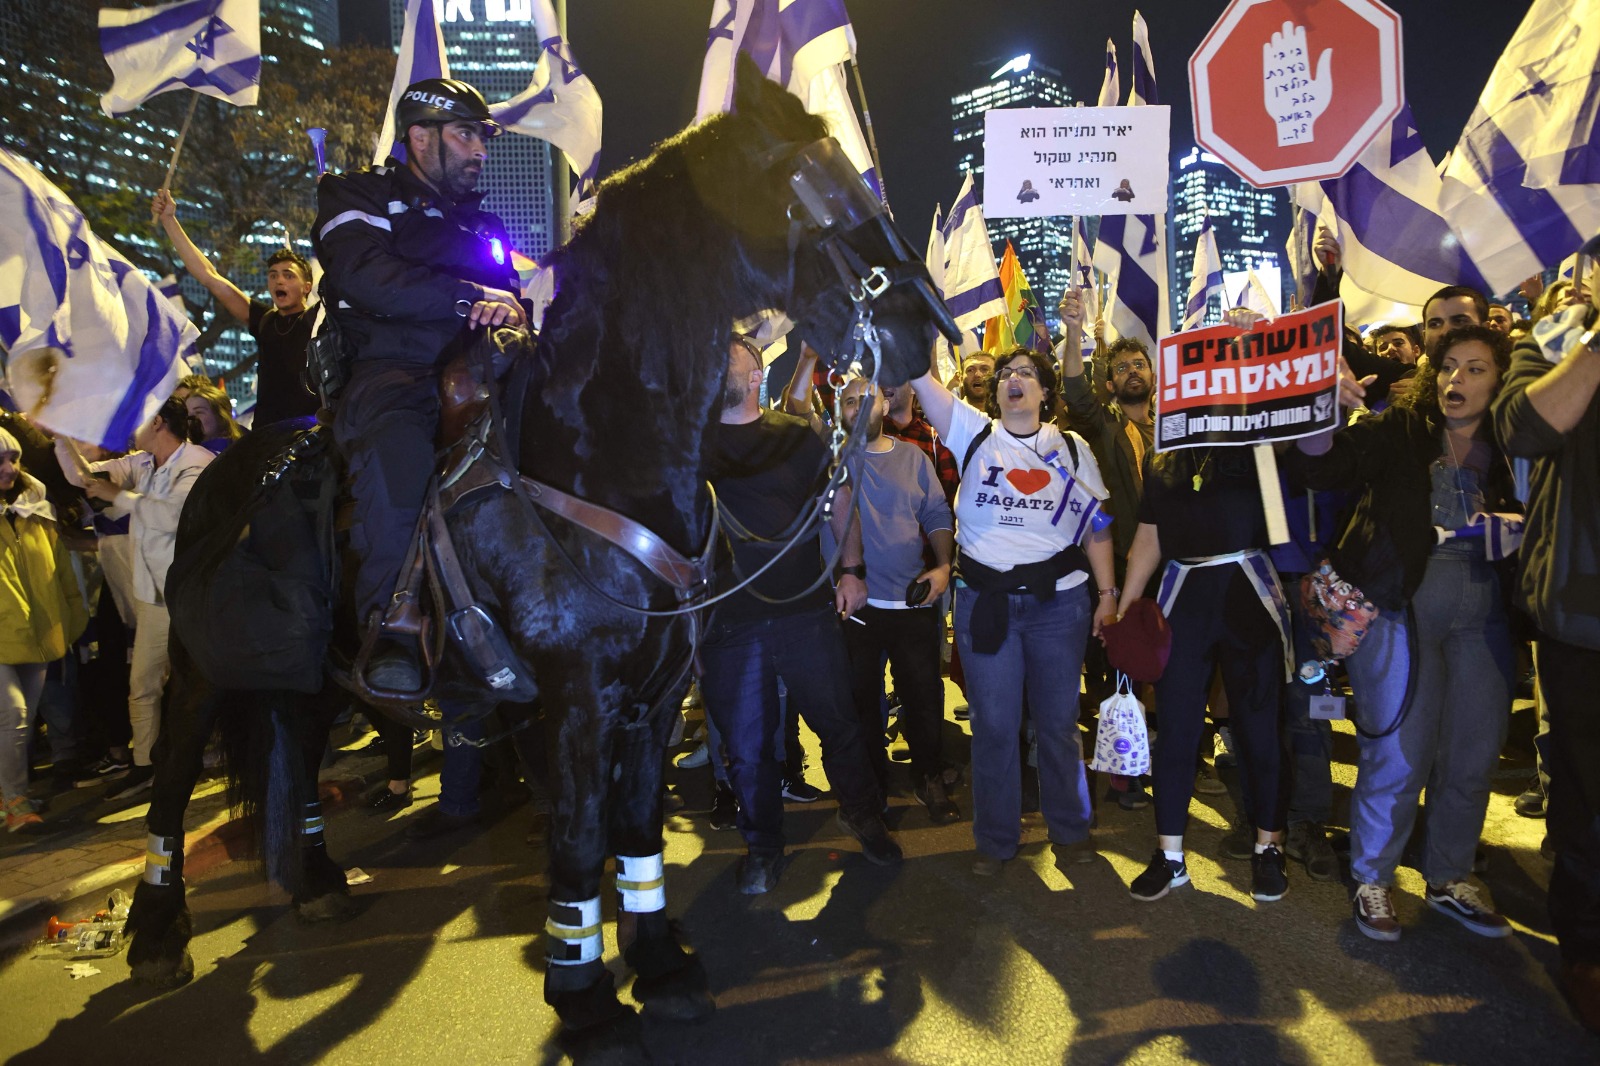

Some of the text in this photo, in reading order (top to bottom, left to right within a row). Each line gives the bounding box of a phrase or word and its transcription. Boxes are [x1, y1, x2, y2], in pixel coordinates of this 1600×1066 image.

[404, 91, 456, 110] POLICE
[1292, 92, 1315, 107] בלב
[1020, 125, 1133, 138] יאיר נתניהו הוא
[1033, 151, 1117, 166] מנהיג שקול
[1182, 315, 1336, 366] מושחתים
[1163, 344, 1336, 401] נמאסתם!
[982, 466, 1004, 487] I
[975, 492, 1054, 511] BAGATZ
[1000, 515, 1023, 523] דרכנו
